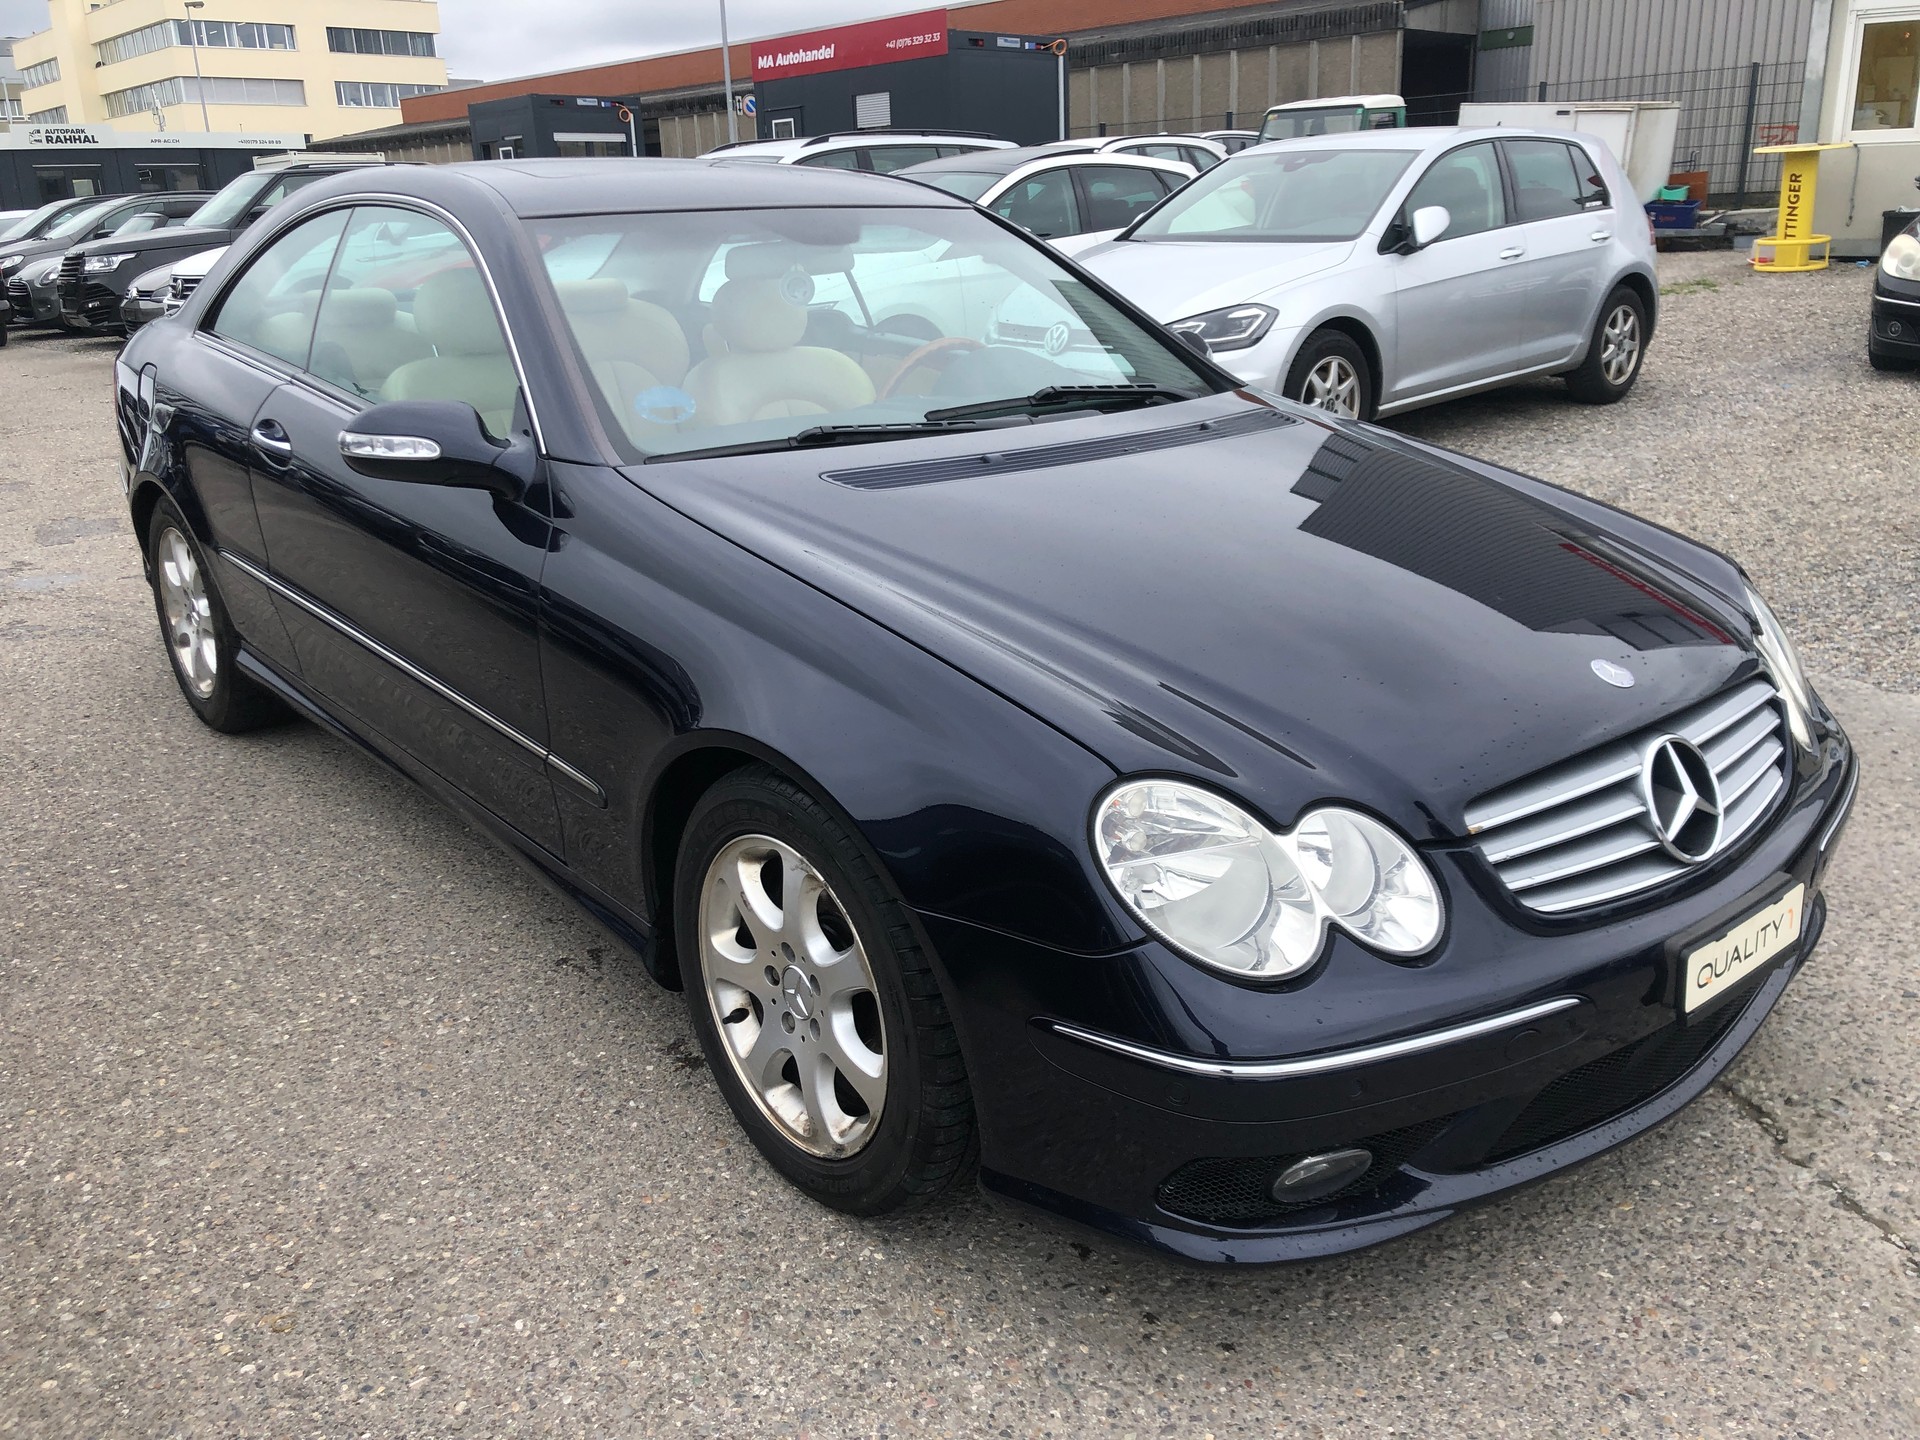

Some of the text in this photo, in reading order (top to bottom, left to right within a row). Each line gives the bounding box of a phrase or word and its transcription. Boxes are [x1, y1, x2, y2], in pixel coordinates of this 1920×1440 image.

[885, 40, 896, 48] +41
[912, 35, 924, 45] 329
[924, 34, 932, 43] 32
[932, 32, 941, 41] 33
[757, 43, 835, 69] MA Autohandel
[45, 135, 99, 144] RAHHAL
